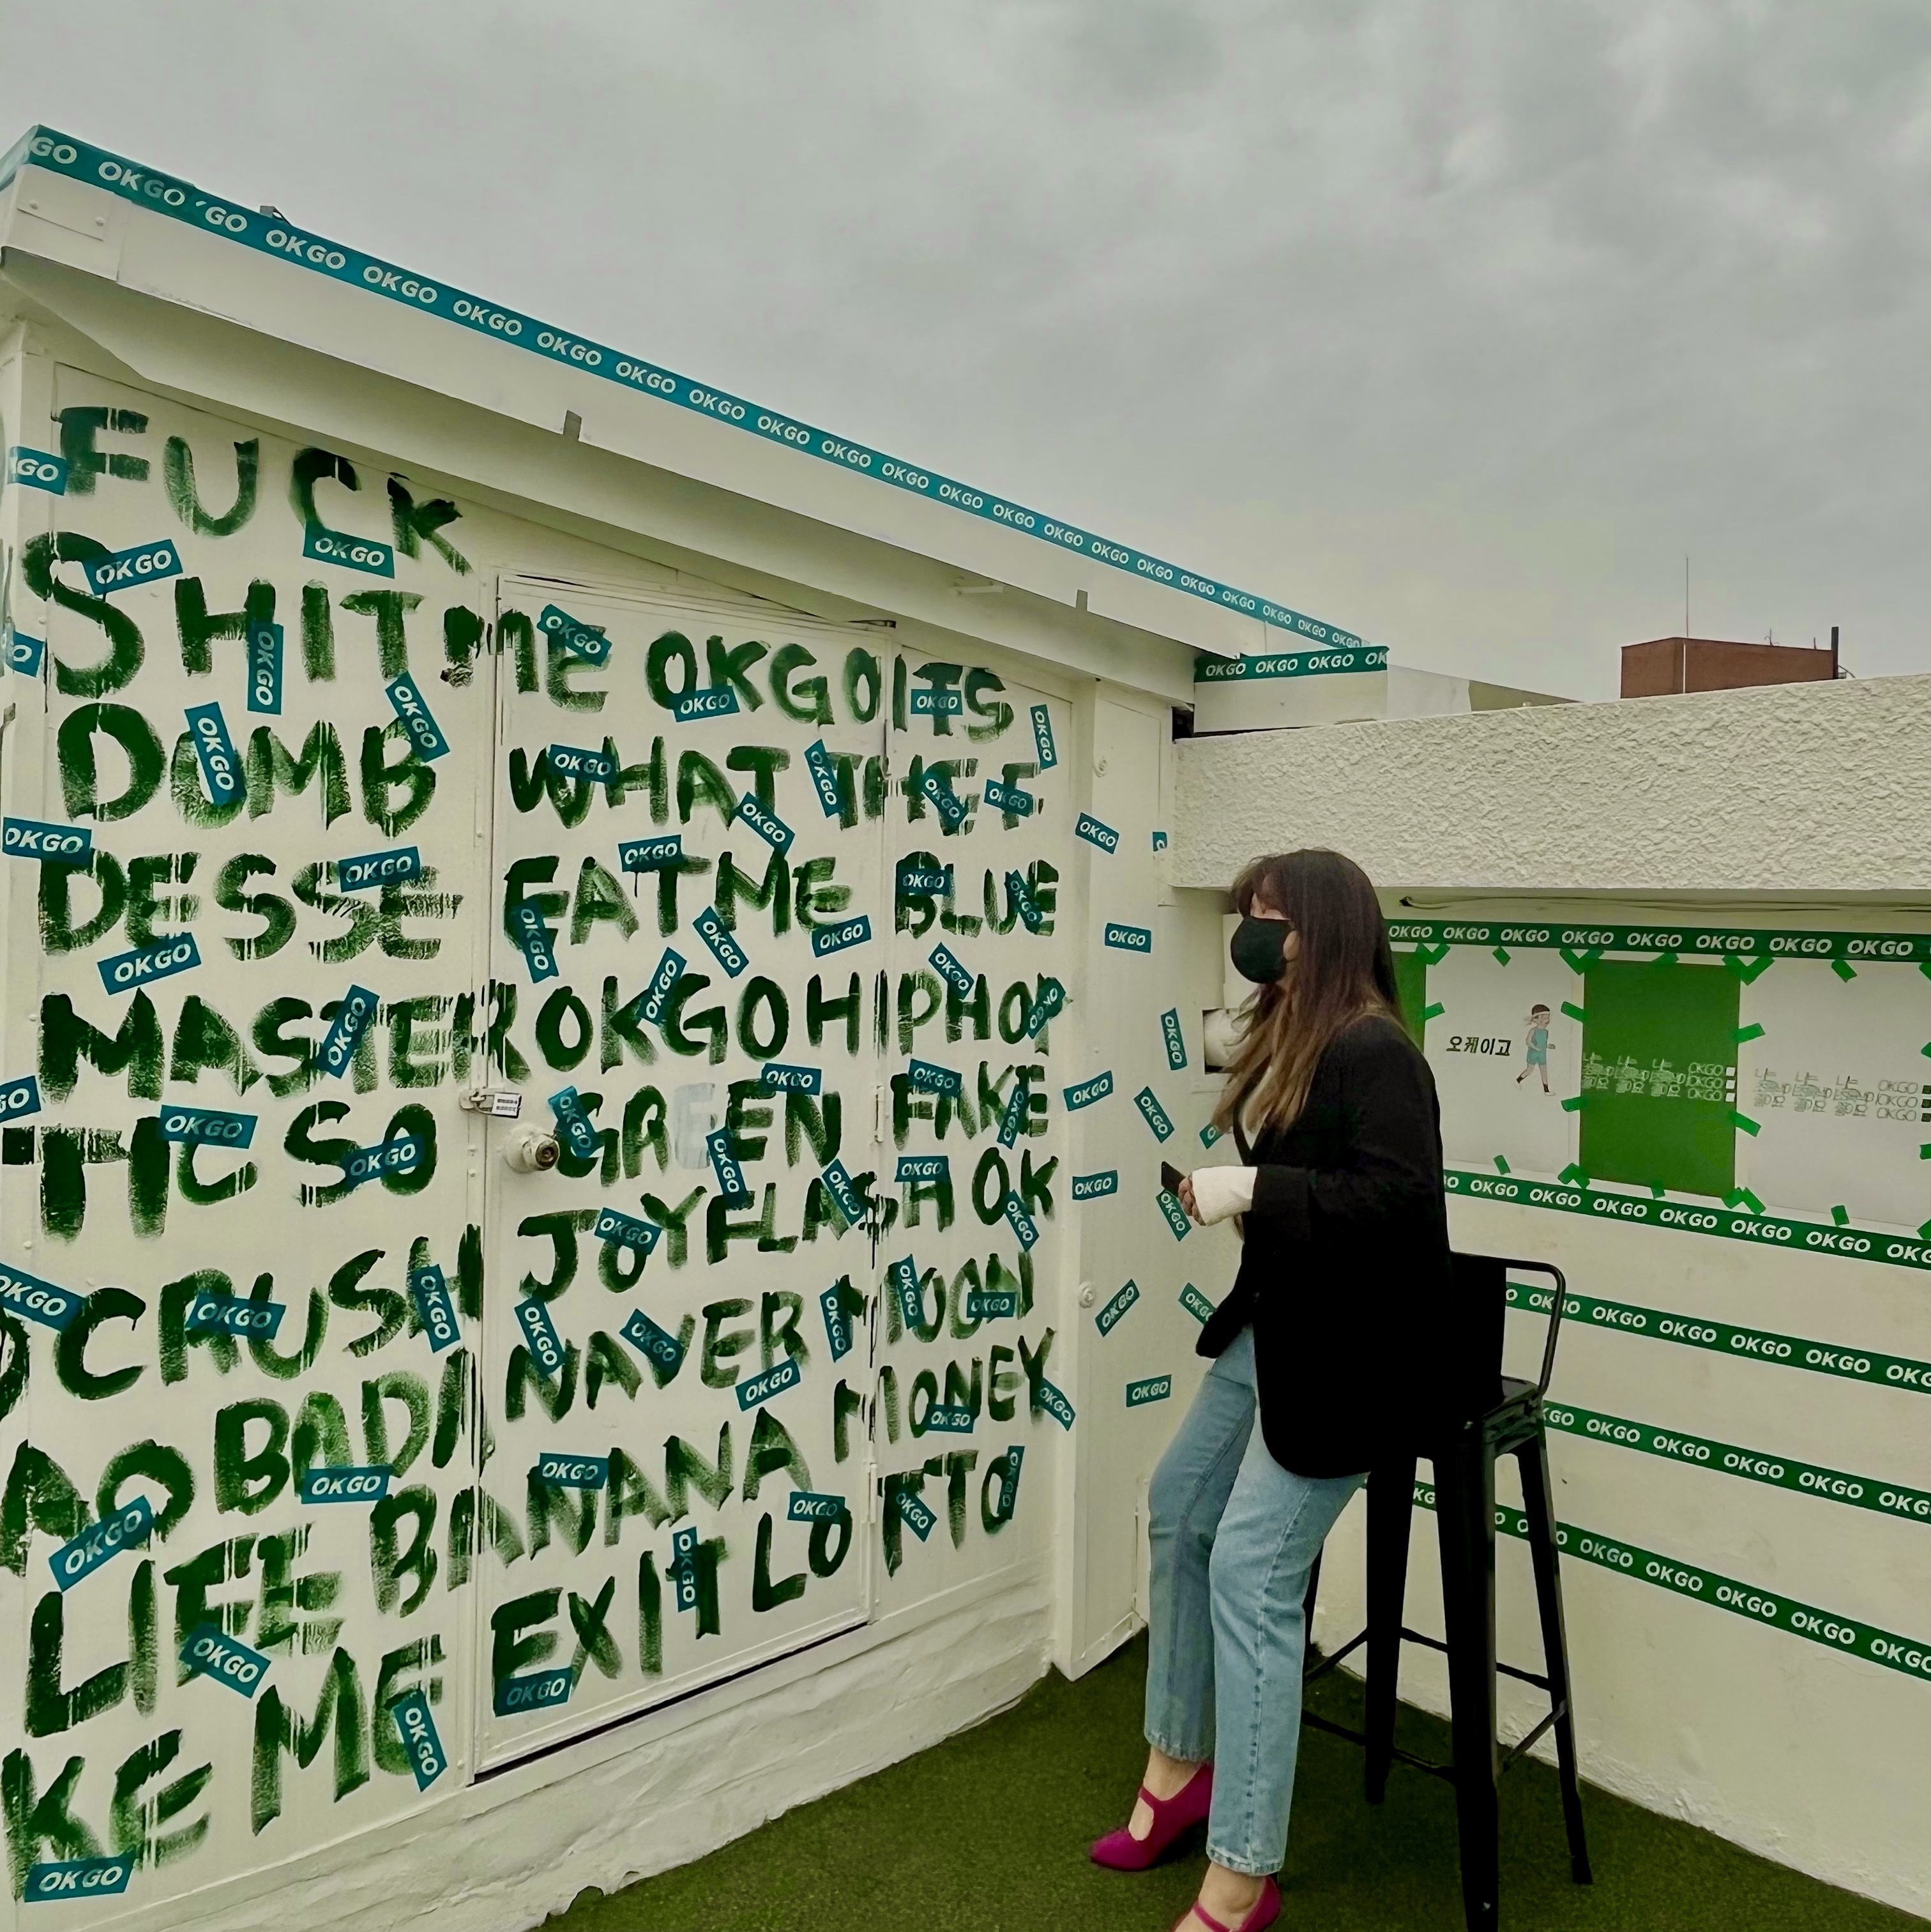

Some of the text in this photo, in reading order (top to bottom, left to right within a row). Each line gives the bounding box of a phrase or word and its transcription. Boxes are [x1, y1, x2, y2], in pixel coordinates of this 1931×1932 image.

[99, 162, 185, 205] OKGO
[266, 230, 345, 269] OKGO
[363, 266, 437, 303] OKGO
[453, 300, 522, 335] OKGO
[537, 333, 602, 365] OKGO
[616, 362, 676, 393] OKGO
[690, 390, 745, 420] OKGO
[758, 416, 810, 445] OKGO
[822, 440, 871, 468] OKGO
[882, 463, 928, 489] OKGO
[940, 484, 983, 508] OKGO
[994, 505, 1034, 528] OKGO
[1044, 524, 1083, 546] OKGO
[1092, 542, 1129, 564] OKGO
[1137, 559, 1173, 580] OKGO
[1181, 575, 1215, 595] OKGO
[1223, 591, 1255, 610] OKGO
[1263, 605, 1291, 624] OKGO
[1298, 620, 1326, 637] OKGO
[52, 406, 474, 575] FUCK
[96, 550, 171, 584] OKGO
[315, 538, 384, 566] OKGO
[21, 531, 424, 698] SHIT
[646, 630, 881, 725] OKGO
[546, 616, 601, 654] OKGO
[256, 630, 274, 706] OKGO
[1206, 654, 1354, 676] OKGO OKGO OKGO
[395, 687, 437, 748] OKGO
[681, 696, 727, 713] OKGO
[198, 718, 234, 789] OKGO
[1035, 711, 1052, 761] OKGO
[510, 735, 790, 828] WHAT
[6, 828, 82, 852] OKGO
[743, 803, 785, 842] OKGO
[1080, 822, 1116, 846] OKGO
[347, 856, 411, 883] OKGO
[625, 843, 678, 864] OKGO
[895, 852, 1059, 939] BLUE
[703, 918, 740, 968] OKGO
[821, 924, 863, 948] OKGO
[1109, 931, 1146, 946] OKGO
[1389, 926, 1913, 955] OKGO OKGO OKGO OKGO OKGO OKGO OKGO OKGO
[115, 944, 190, 982] OKGO
[935, 953, 969, 990] OKGO
[646, 960, 676, 1018] OKGO
[38, 978, 531, 1104] MASTER
[536, 974, 789, 1074] OKGO
[328, 997, 366, 1066] OKGO
[1165, 1016, 1182, 1063] OKGO
[1446, 1036, 1511, 1056] 오케이고
[1073, 1079, 1108, 1103] OKGO
[165, 1116, 242, 1137] OKGO
[1141, 1097, 1167, 1134] OKGO
[715, 1139, 739, 1192] OKGO
[971, 1147, 1058, 1226] OK
[1075, 1178, 1111, 1194] OKGO
[1008, 1201, 1033, 1241] OKGO
[1471, 1180, 1518, 1196] OKGO
[1530, 1189, 1580, 1206] OKGO
[1593, 1199, 1647, 1217] OKGO
[1660, 1209, 1717, 1228] OKGO
[1731, 1220, 1791, 1240] OKGO
[1806, 1231, 1870, 1252] OKGO
[0, 1275, 66, 1316] OKGO
[198, 1303, 271, 1326] OKGO
[421, 1276, 450, 1339] OKGO
[1102, 1287, 1134, 1327] OKGO
[525, 1307, 557, 1365] OKGO
[1593, 1307, 1870, 1373] OKGO OKGO OKGO OKGO
[746, 1367, 792, 1401] OKGO
[1132, 1381, 1168, 1400] OKGO
[1040, 1387, 1071, 1422] OKGO
[543, 1462, 598, 1479] OKGO
[1587, 1419, 1863, 1498] OKGO OKGO OKGO OKGO
[312, 1476, 381, 1495] OKGO
[902, 1494, 928, 1528] OKGO
[66, 1510, 142, 1574] OKGO
[1580, 1539, 1633, 1567] OKGO
[1646, 1562, 1702, 1591] OKGO
[1716, 1586, 1776, 1617] OKGO
[1791, 1612, 1855, 1644] OKGO
[25, 1521, 345, 1737] LIFE
[491, 1536, 727, 1716] EXIT
[194, 1638, 259, 1682] OKGO
[405, 1708, 437, 1775] OKGO
[39, 1866, 123, 1891] OKGO
